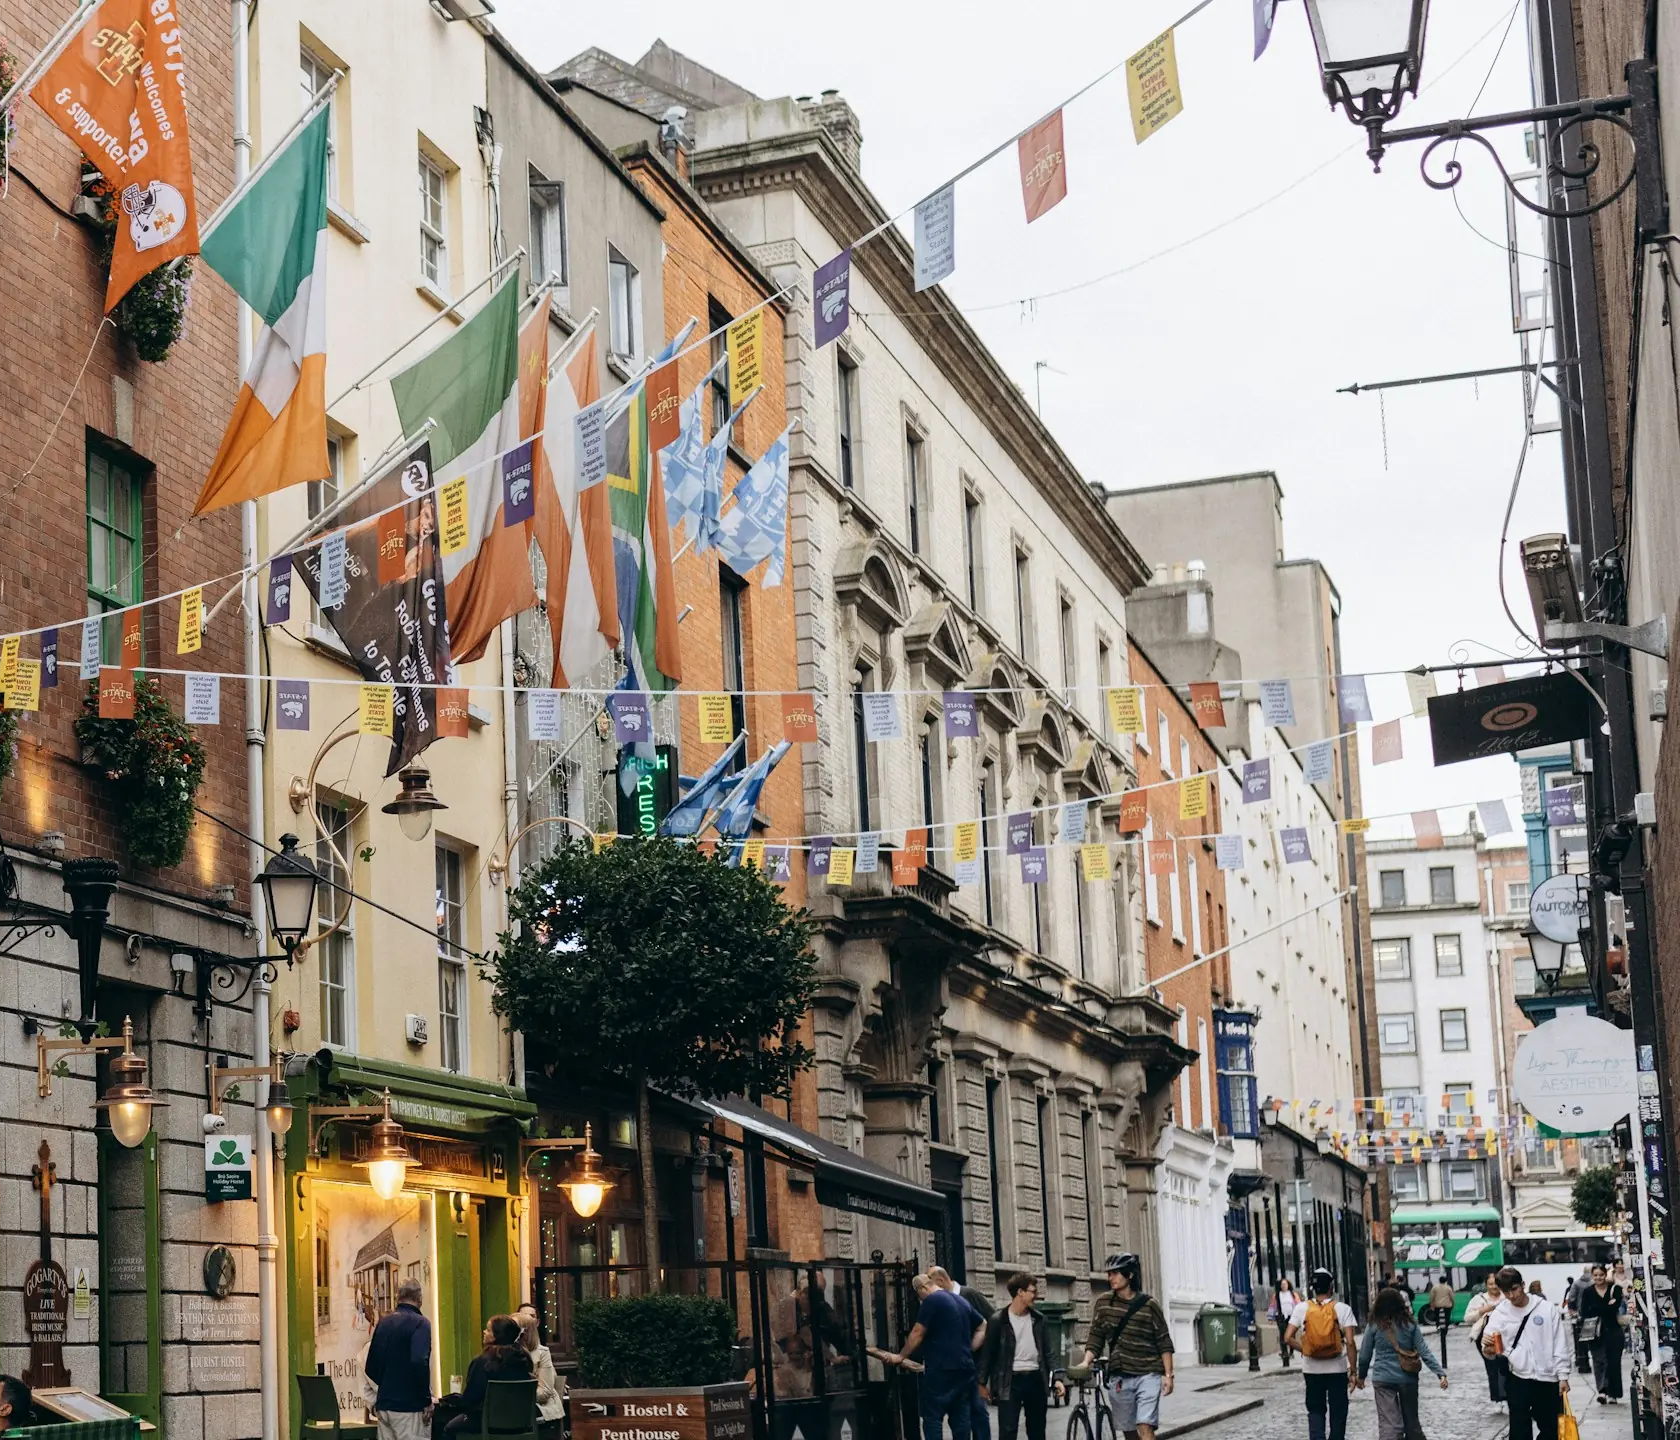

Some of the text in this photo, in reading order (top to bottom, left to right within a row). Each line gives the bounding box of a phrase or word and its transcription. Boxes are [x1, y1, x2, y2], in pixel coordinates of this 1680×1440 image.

[1141, 68, 1165, 91] IOWA
[55, 88, 72, 104] &
[1141, 77, 1167, 102] STATE
[140, 60, 175, 141] Welcomes
[363, 639, 380, 660] to
[26, 1267, 67, 1298] GOGARTY'S
[39, 1299, 55, 1310] LIVE
[30, 1312, 65, 1320] TRADITIONAL
[31, 1323, 63, 1332] IRISH MUSIC
[33, 1334, 62, 1342] & BALLADS
[190, 1356, 246, 1368] TOURIST HOSTEL
[328, 1360, 343, 1378] The
[339, 1392, 346, 1409] &
[623, 1404, 689, 1417] Hostel &
[601, 1429, 680, 1440] Penthouse
